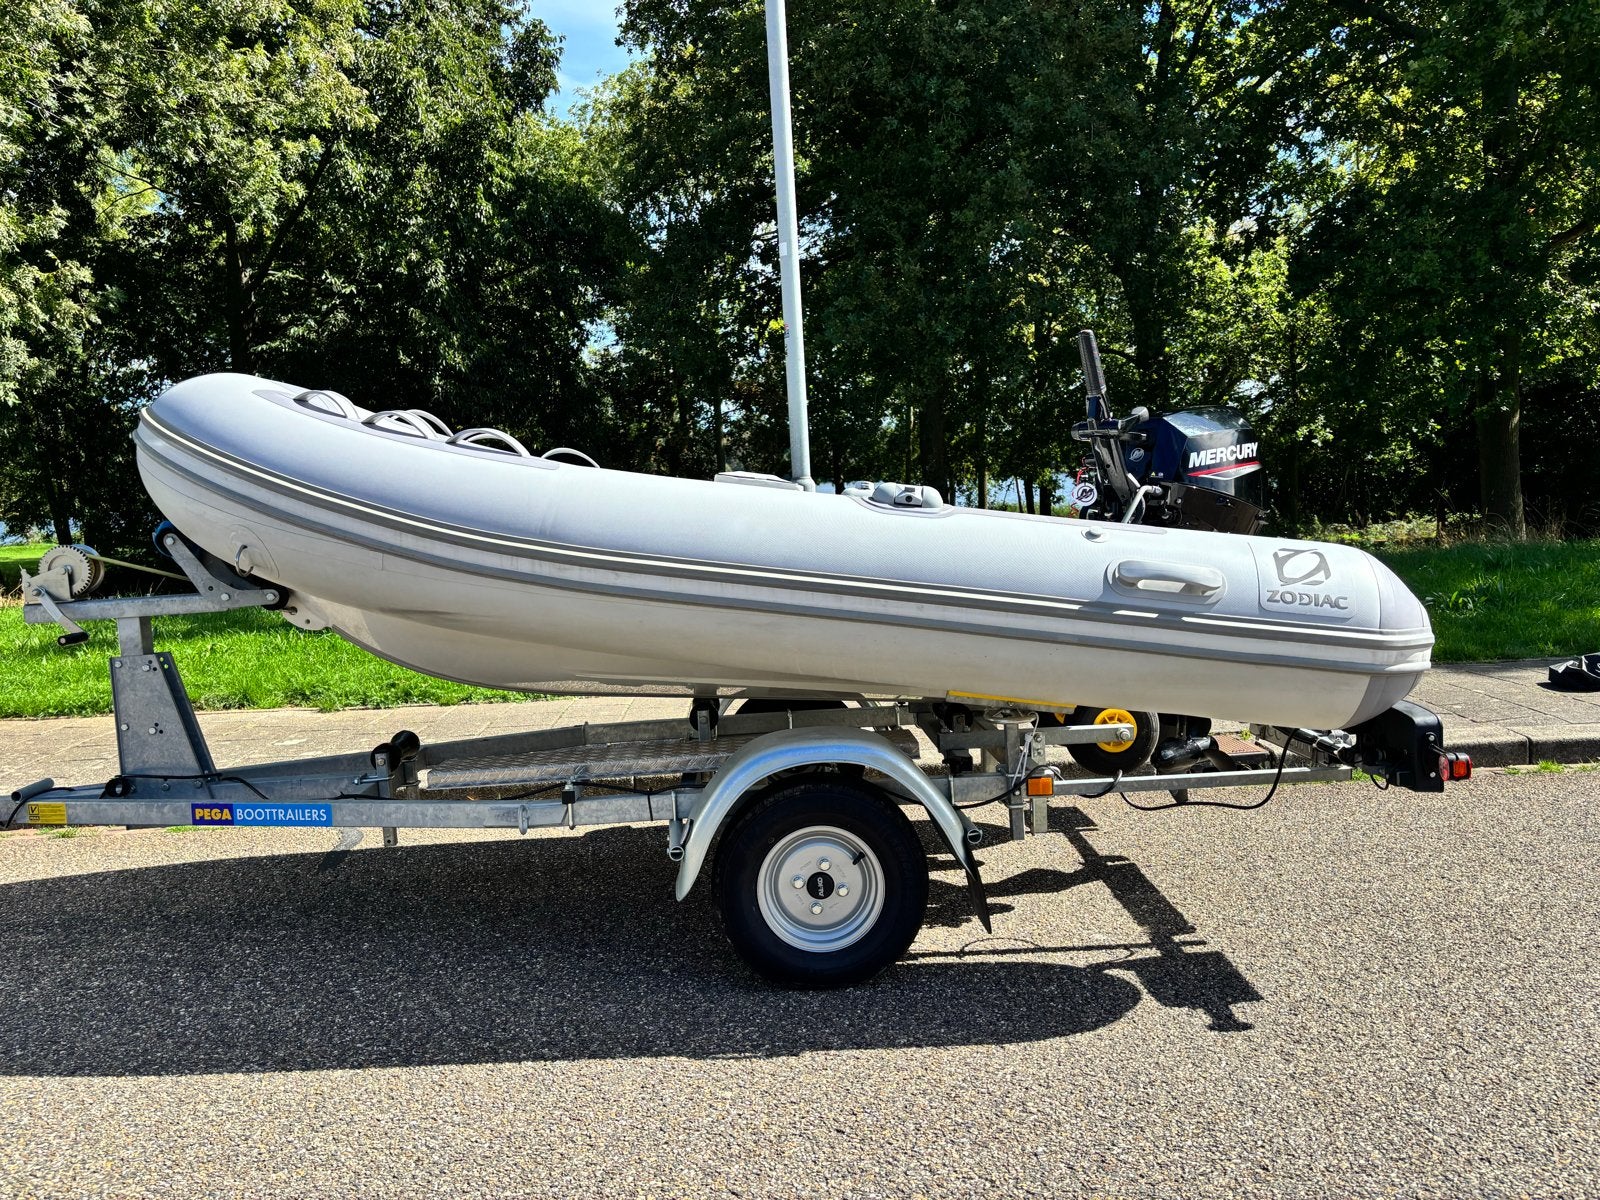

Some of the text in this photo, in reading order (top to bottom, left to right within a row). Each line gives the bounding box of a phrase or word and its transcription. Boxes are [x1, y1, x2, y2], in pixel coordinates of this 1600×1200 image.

[1188, 442, 1258, 469] MERCURY
[1266, 589, 1349, 610] ZODIAC
[194, 808, 327, 821] PEGA BOOTTRAILERS
